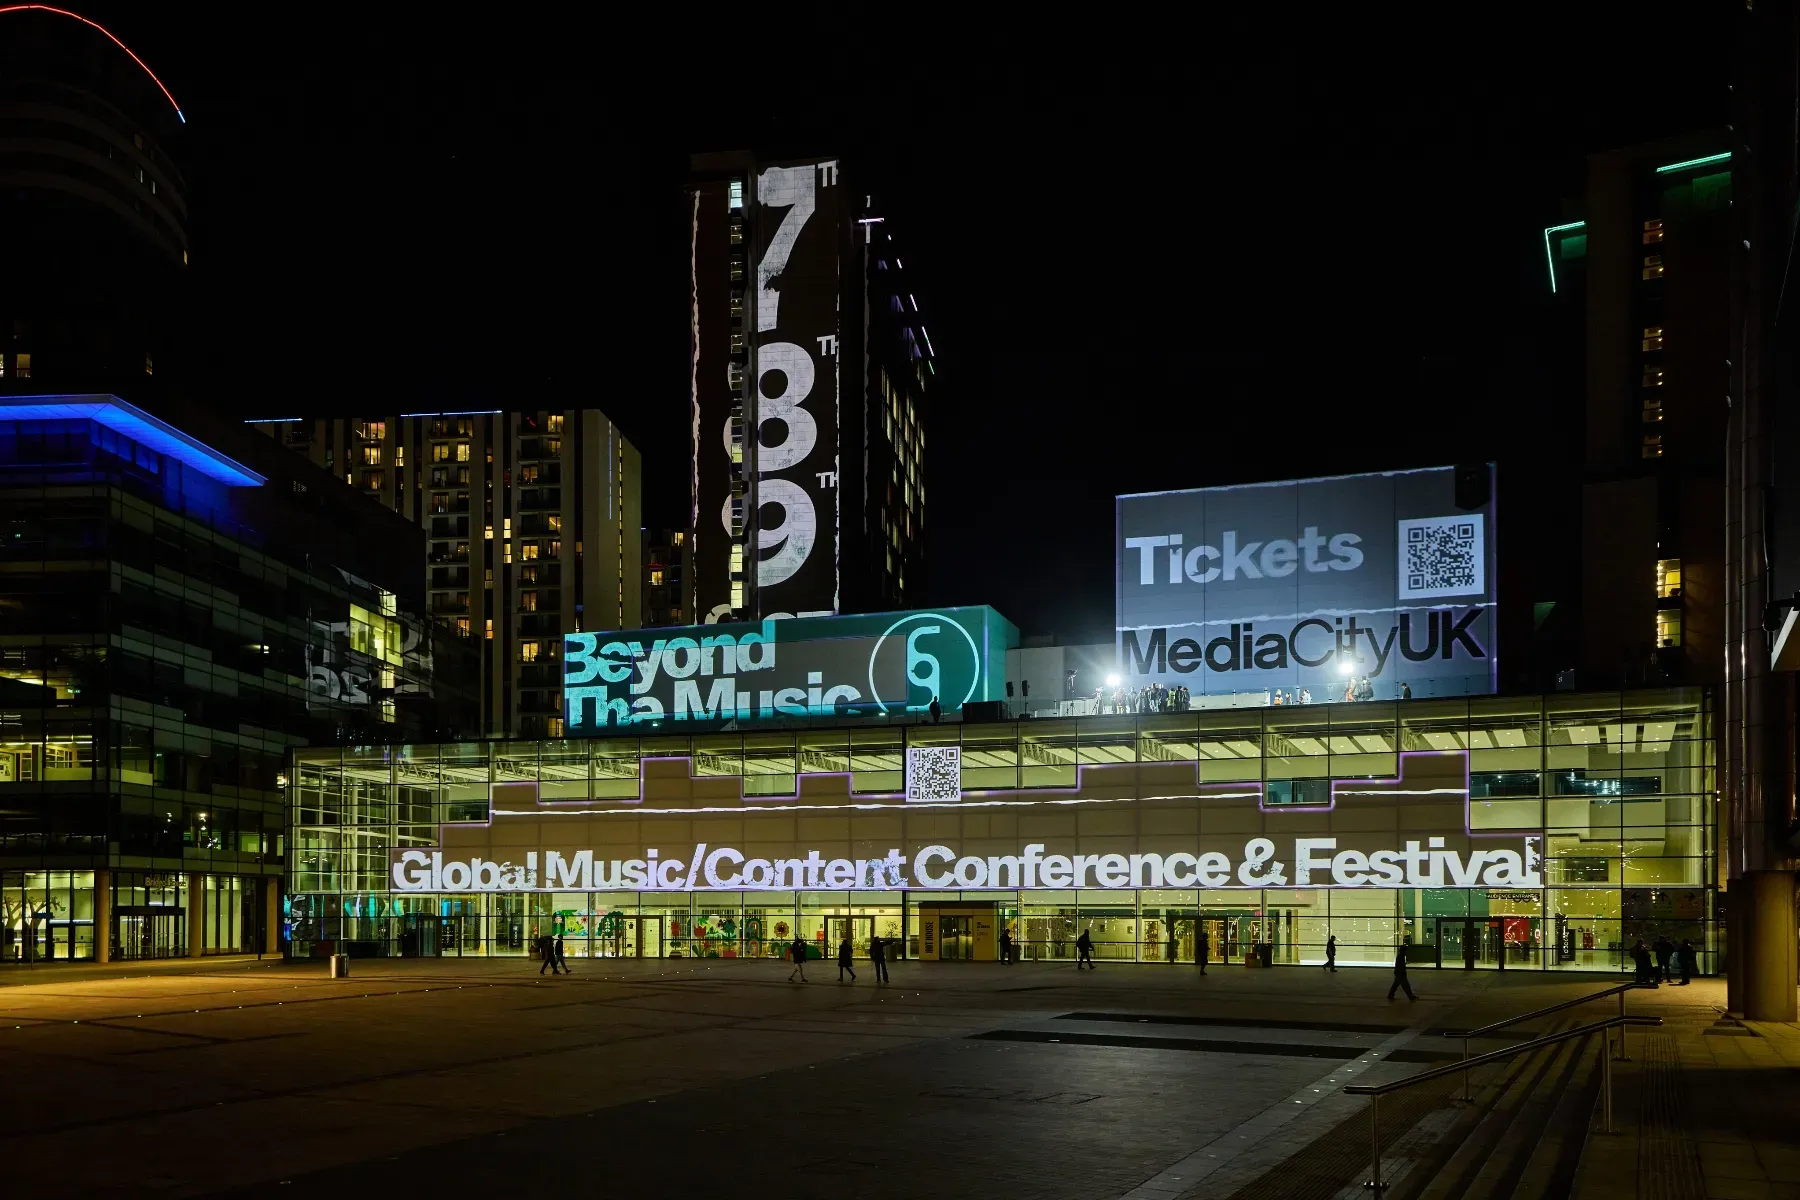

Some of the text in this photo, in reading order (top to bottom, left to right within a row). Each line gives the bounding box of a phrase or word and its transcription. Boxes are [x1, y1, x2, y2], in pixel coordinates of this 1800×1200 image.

[1125, 525, 1364, 585] Tickets
[565, 619, 776, 695] Beyond
[1122, 607, 1487, 679] MediaCityUK
[674, 671, 862, 722] Music
[393, 836, 1541, 891] Global Music/Content Conference & Festival
[925, 921, 934, 954] HOT HOUSE
